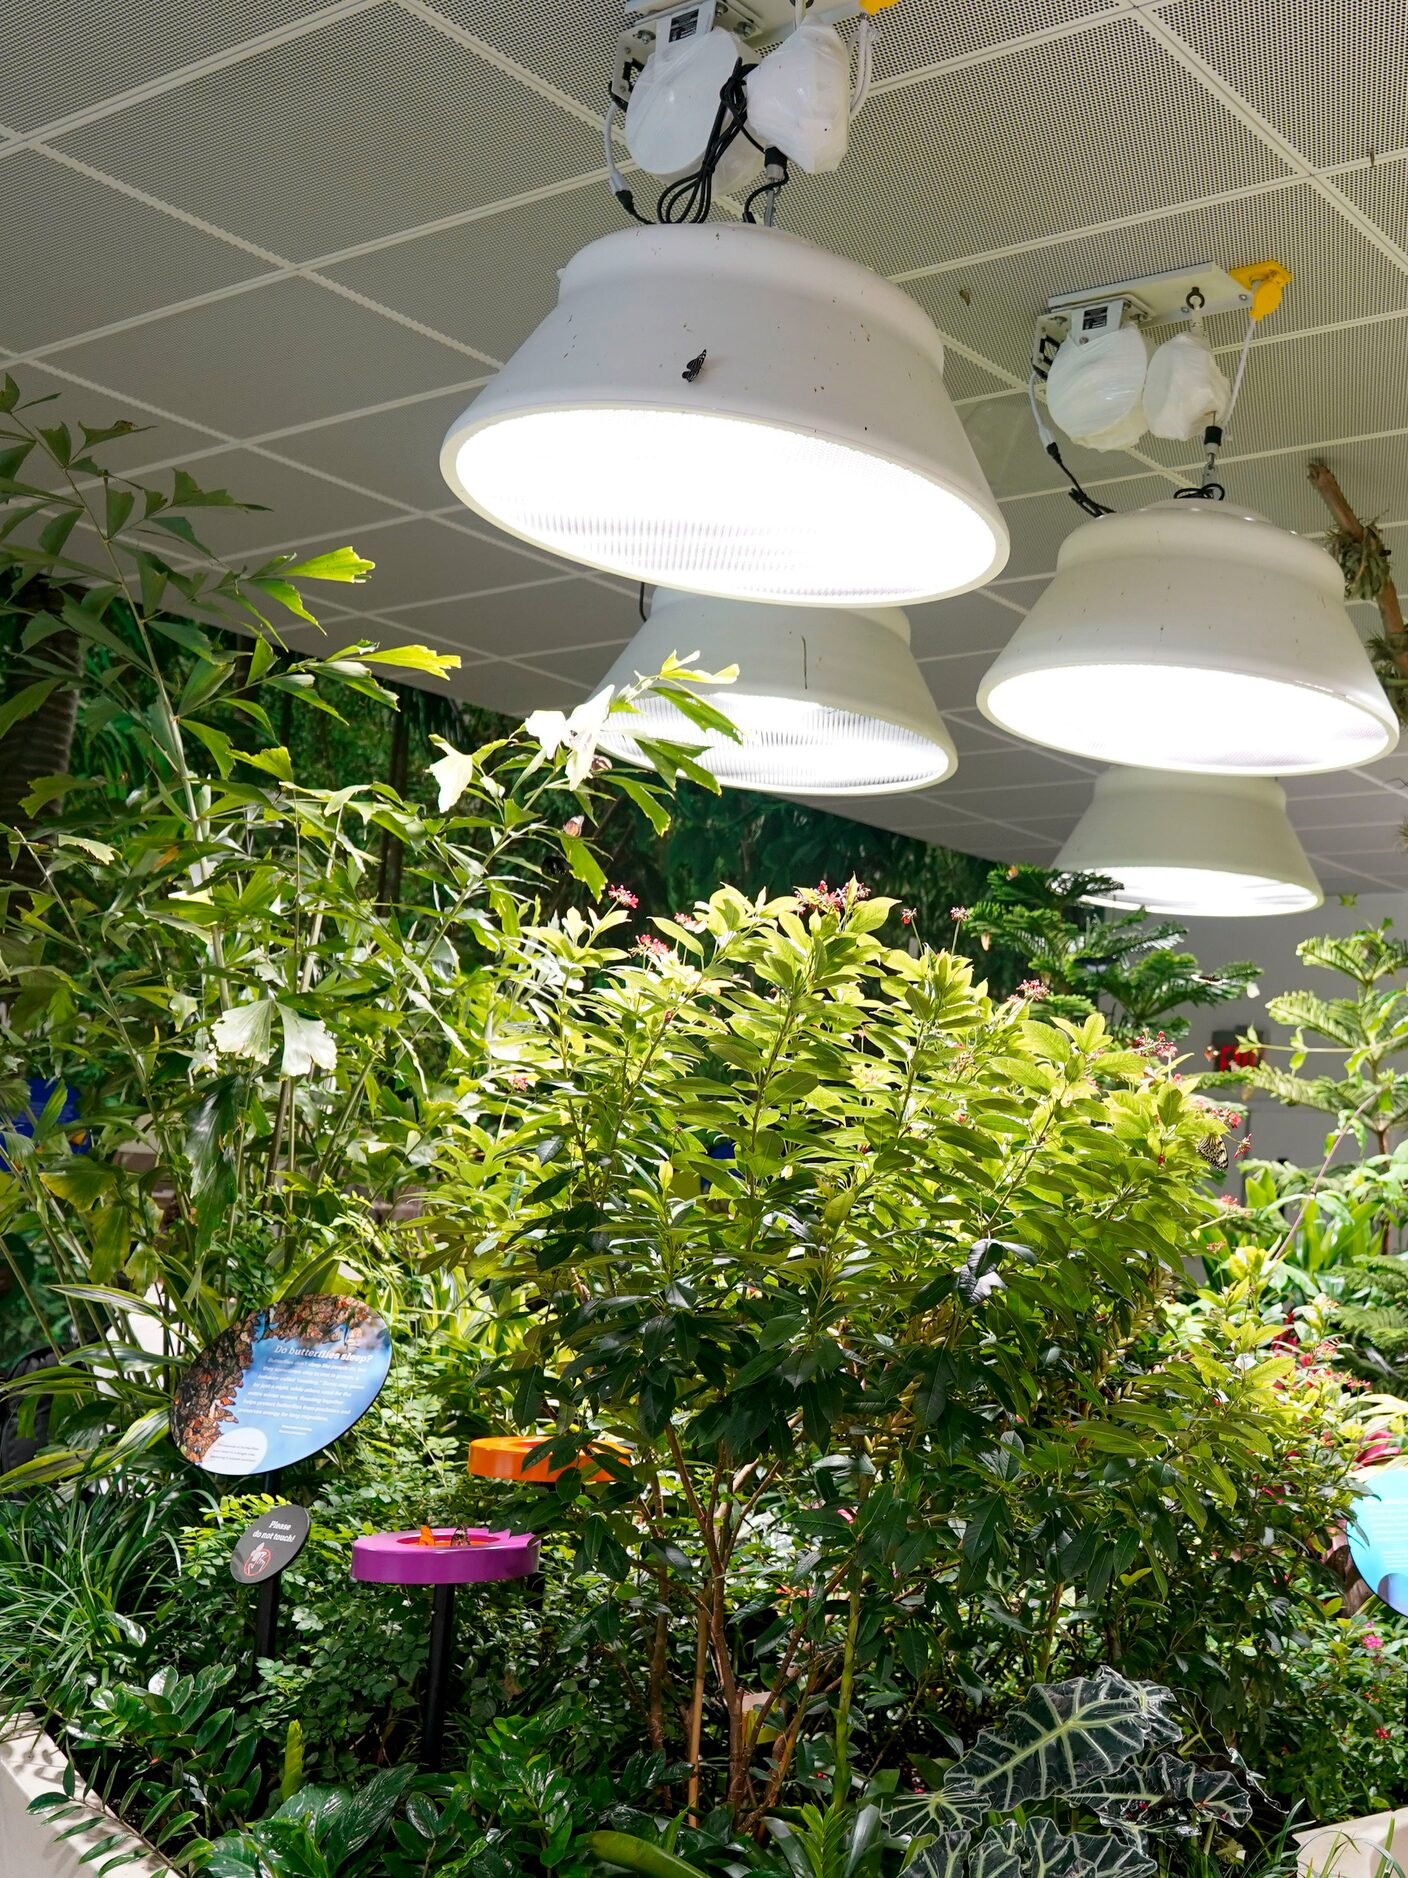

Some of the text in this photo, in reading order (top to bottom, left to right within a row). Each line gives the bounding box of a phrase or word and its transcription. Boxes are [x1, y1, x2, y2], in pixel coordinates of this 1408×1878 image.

[274, 1345, 374, 1364] Do butterflies sleep?
[268, 1520, 292, 1531] Please
[252, 1530, 296, 1543] do not touch!
